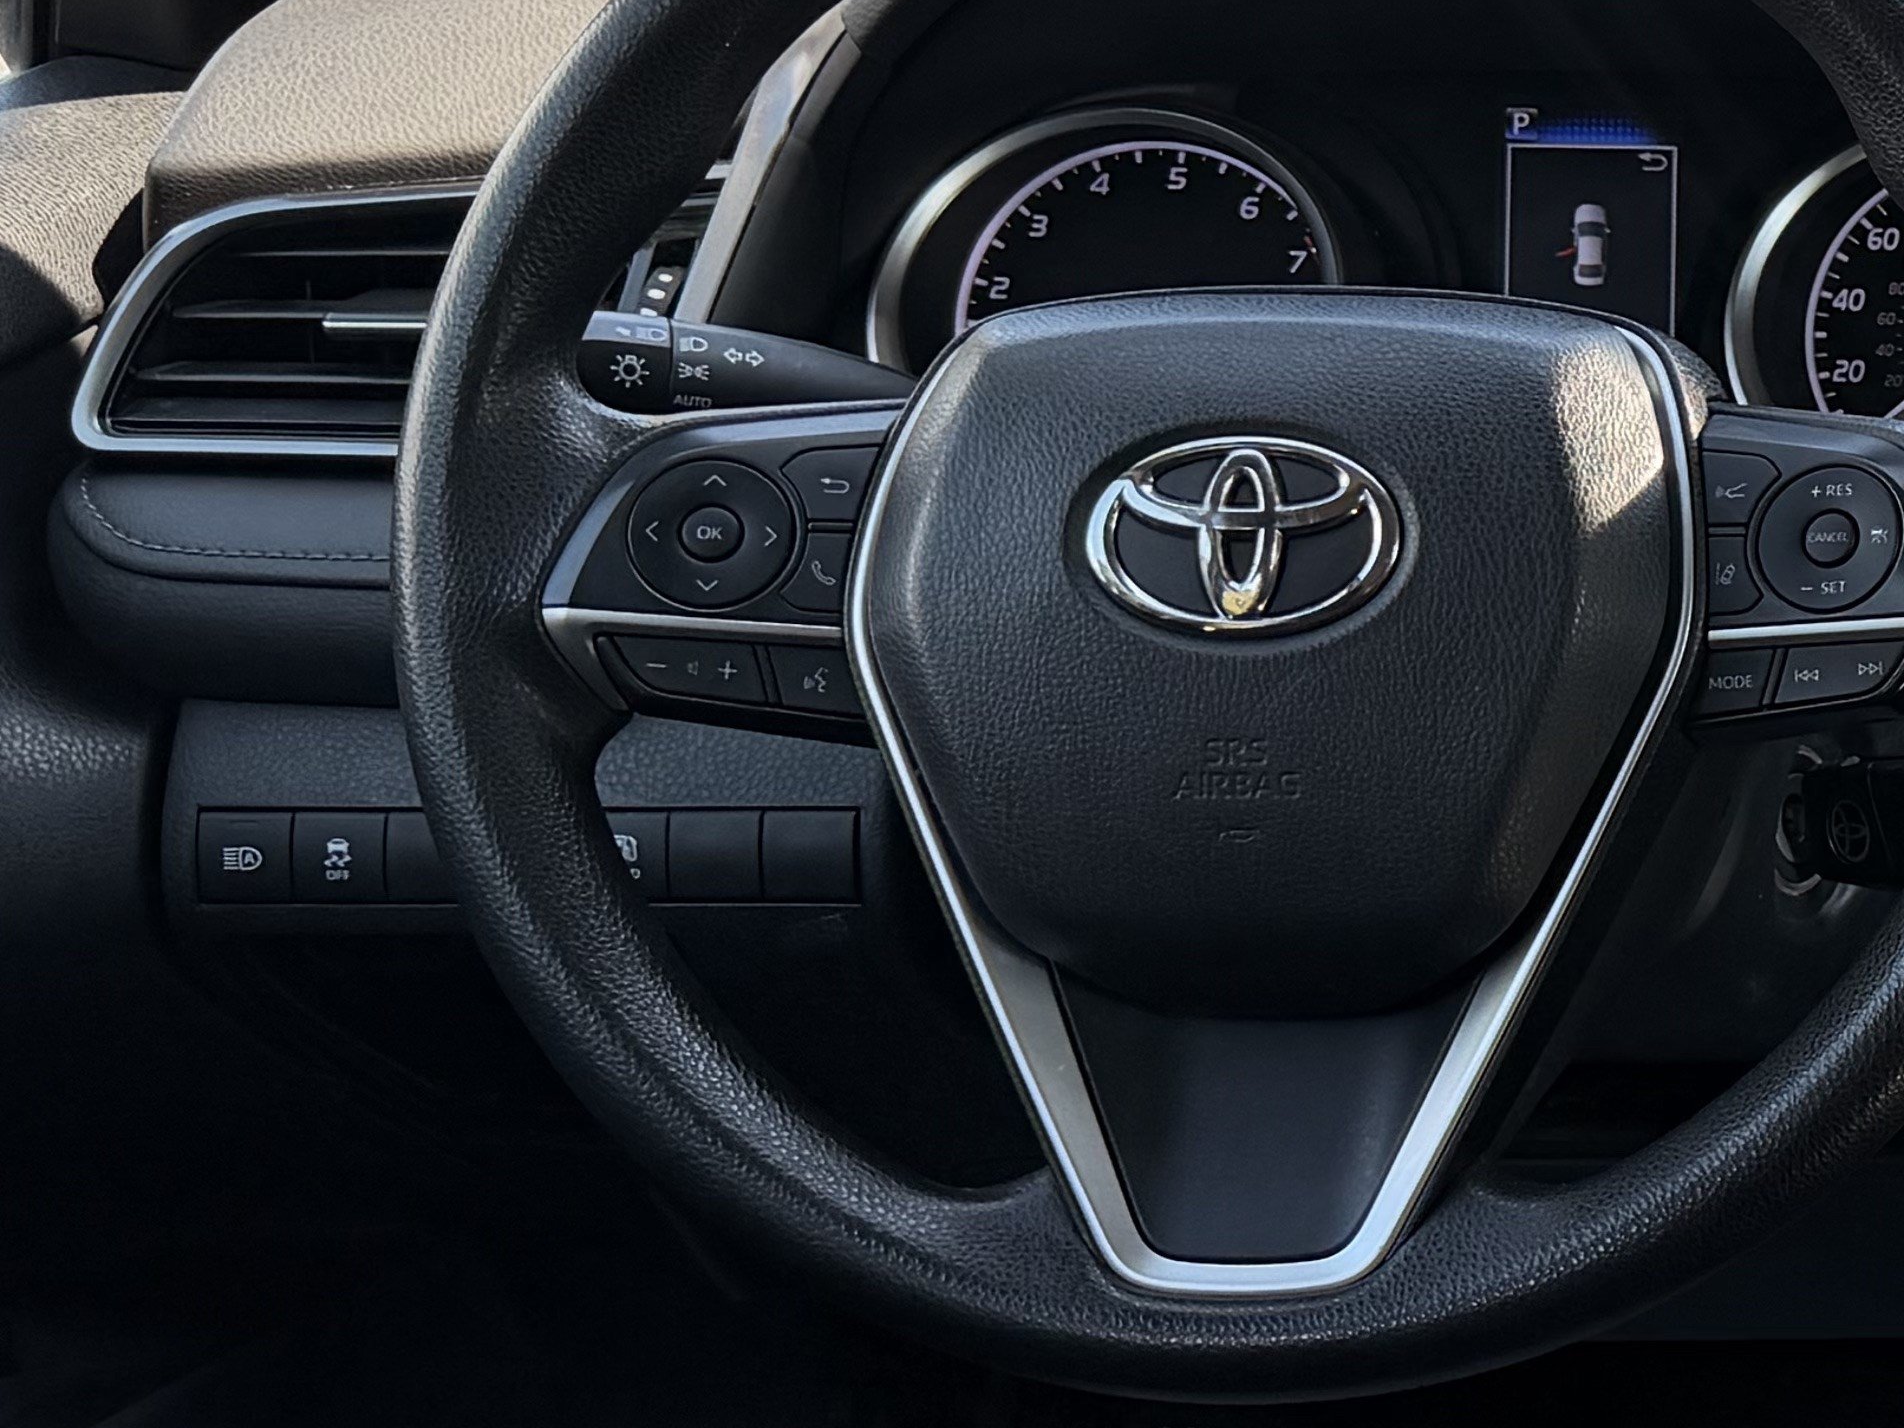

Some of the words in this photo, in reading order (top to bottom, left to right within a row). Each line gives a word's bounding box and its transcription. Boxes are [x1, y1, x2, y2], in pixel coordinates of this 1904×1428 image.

[1512, 112, 1531, 136] P
[1090, 173, 1110, 195] 4
[1167, 167, 1188, 190] 5
[1239, 197, 1260, 220] 6
[1028, 215, 1049, 237] 3
[1867, 228, 1900, 251] 60
[1288, 250, 1308, 274] 7
[989, 277, 1010, 299] 2
[1832, 289, 1865, 312] 40
[1877, 312, 1896, 326] 60
[1875, 343, 1894, 357] 40
[1832, 360, 1865, 383] 20
[673, 394, 712, 408] AUTO
[1826, 483, 1853, 497] RES
[696, 525, 723, 540] OK
[1807, 531, 1848, 543] CANCEL
[1820, 580, 1846, 594] SET
[1708, 675, 1752, 690] MODE
[1206, 737, 1268, 767] SRS
[1172, 773, 1301, 800] AIRBAG
